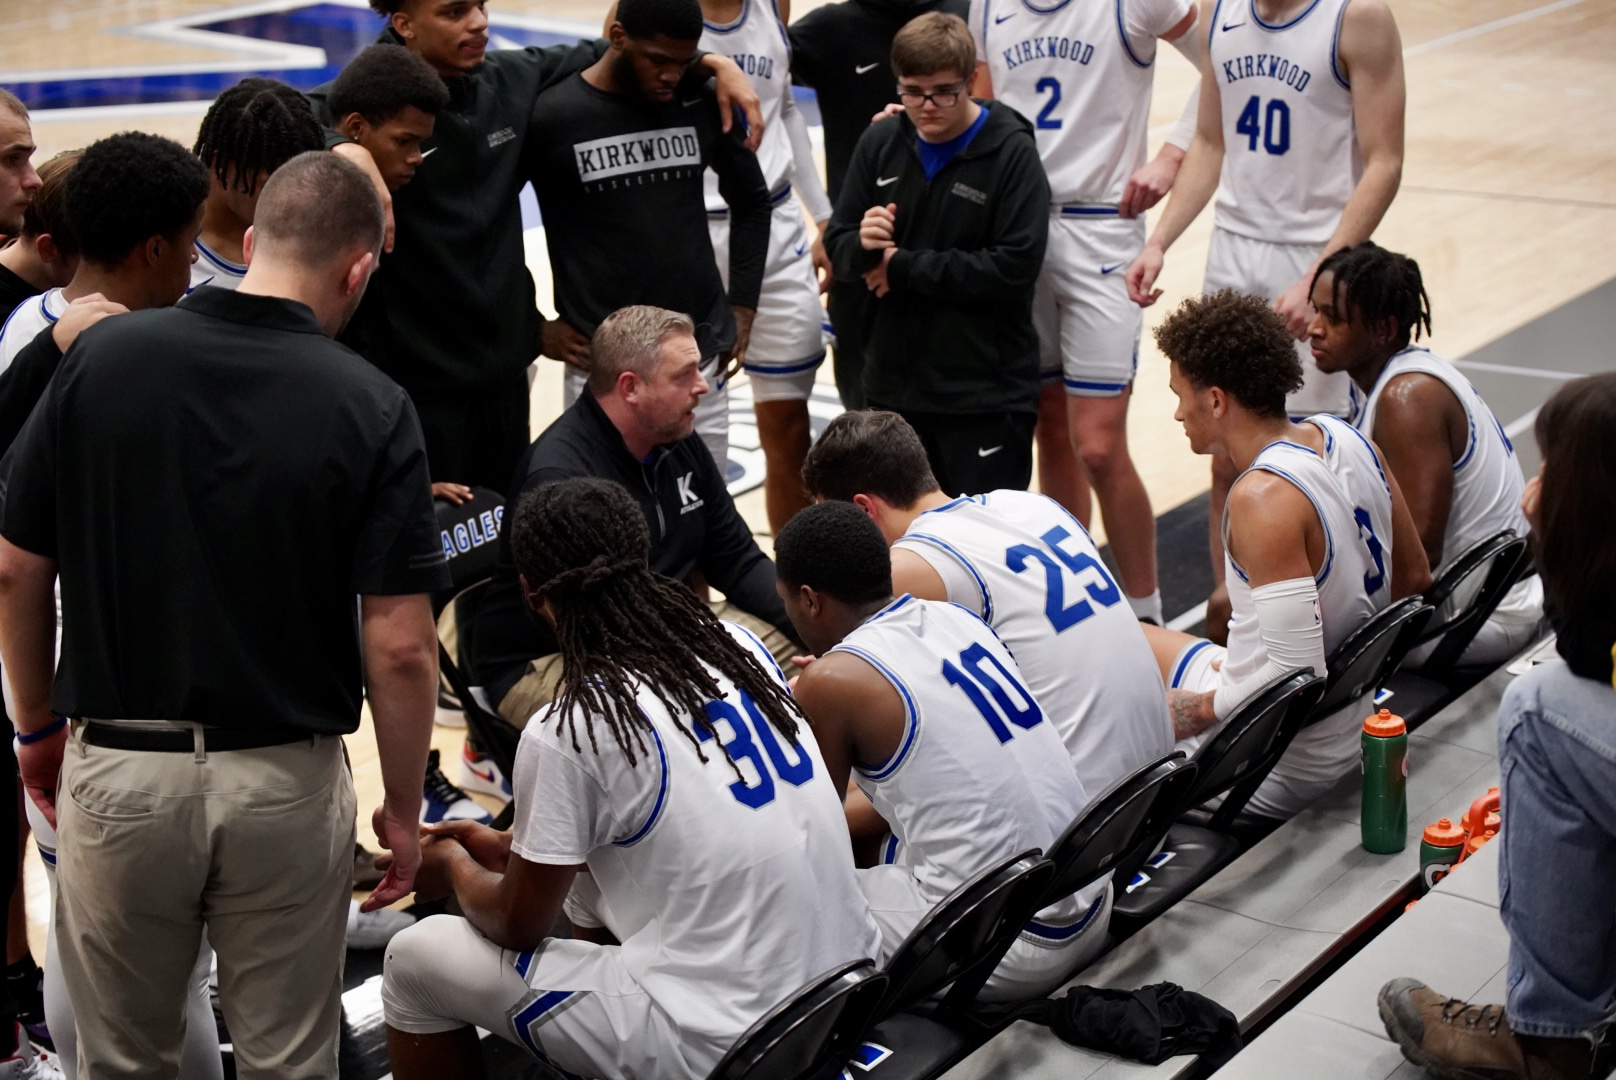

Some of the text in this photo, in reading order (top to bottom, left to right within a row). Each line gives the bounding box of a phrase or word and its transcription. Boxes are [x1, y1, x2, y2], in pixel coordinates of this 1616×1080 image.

[1002, 36, 1095, 70] KIRKWOOD
[1223, 54, 1311, 92] KIRKWOOD
[1035, 76, 1062, 129] 2
[1236, 94, 1291, 156] 40
[578, 134, 697, 174] KIRKWOOD
[676, 471, 699, 506] K
[440, 505, 504, 560] AGLES
[1353, 506, 1386, 597] 3
[1004, 524, 1122, 636] 25
[940, 641, 1044, 746] 10
[692, 687, 815, 812] 30
